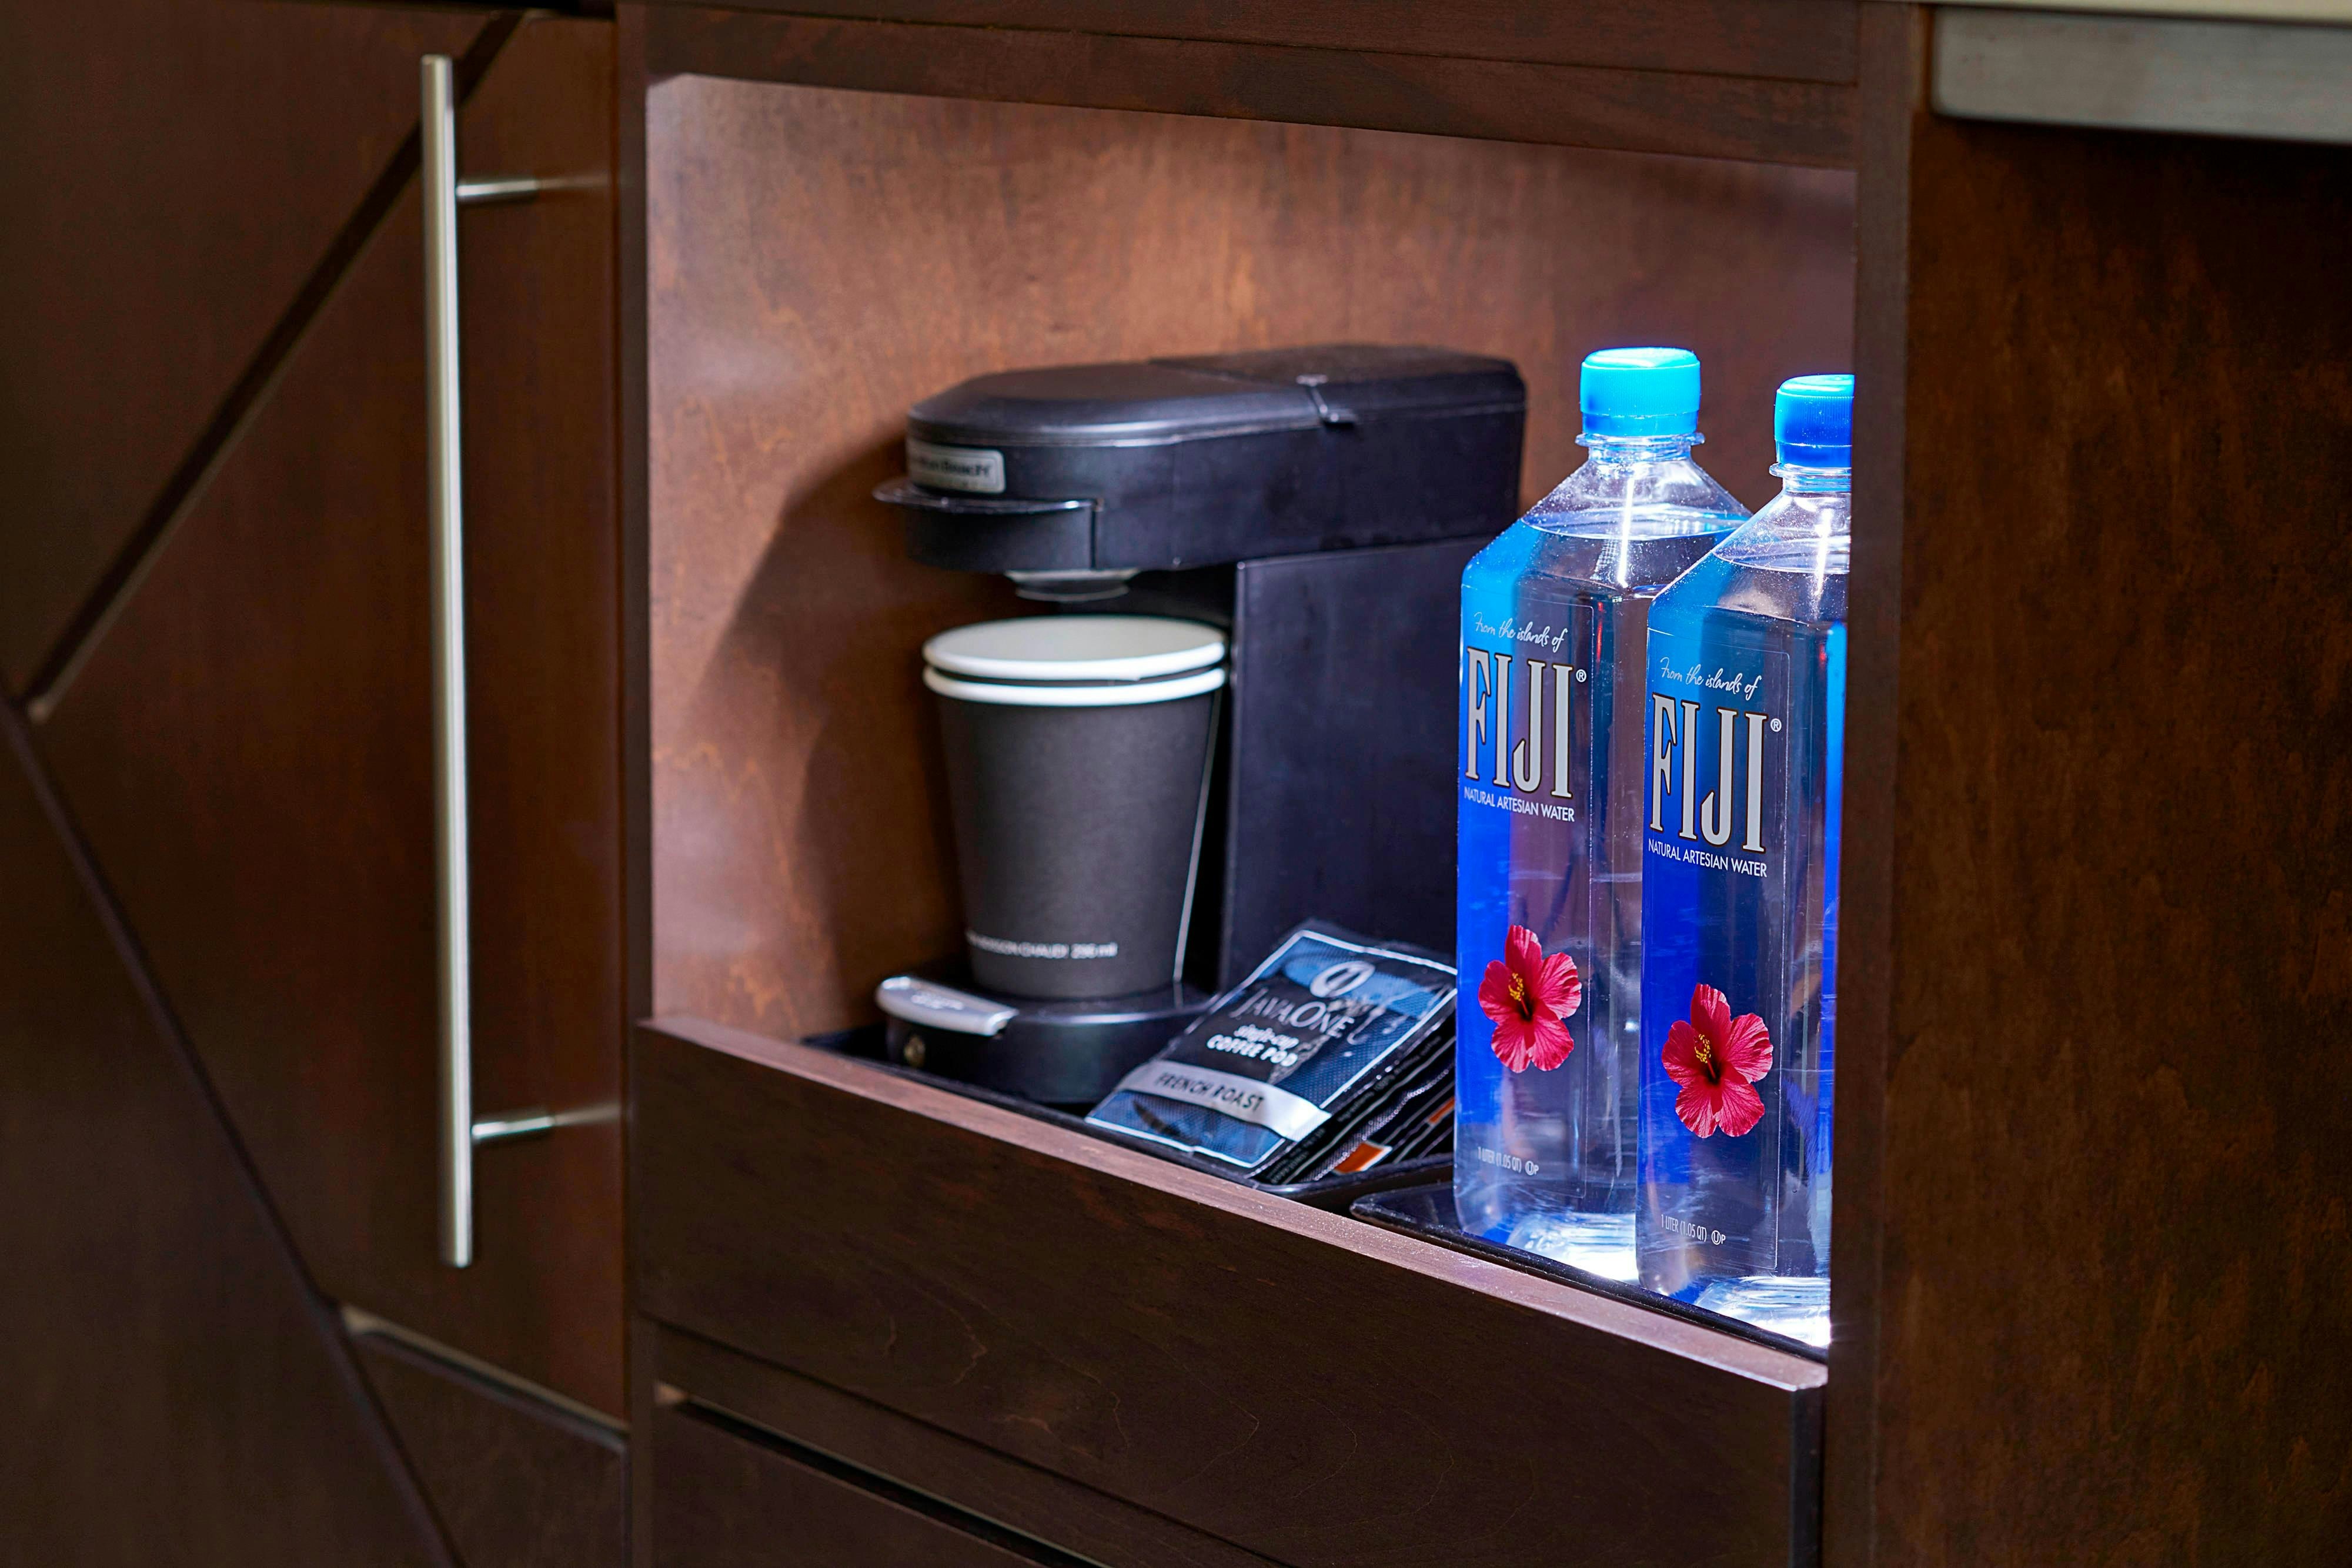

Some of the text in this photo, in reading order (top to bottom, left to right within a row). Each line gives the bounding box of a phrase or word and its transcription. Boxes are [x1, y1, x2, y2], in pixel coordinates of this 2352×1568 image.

[1474, 611, 1568, 653] From the islands of
[1660, 657, 1762, 701] From the islands of
[1464, 786, 1575, 823] NATURAL ARTESIAN WATER
[1648, 838, 1768, 878] NATURAL ARTESIAN WATER
[1207, 1034, 1298, 1067] COFFEE POD
[1155, 1072, 1264, 1112] FRENCH ROAST
[1665, 1215, 1679, 1233] LITER
[1680, 1220, 1696, 1238] (1.05
[1696, 1225, 1708, 1242] QT)
